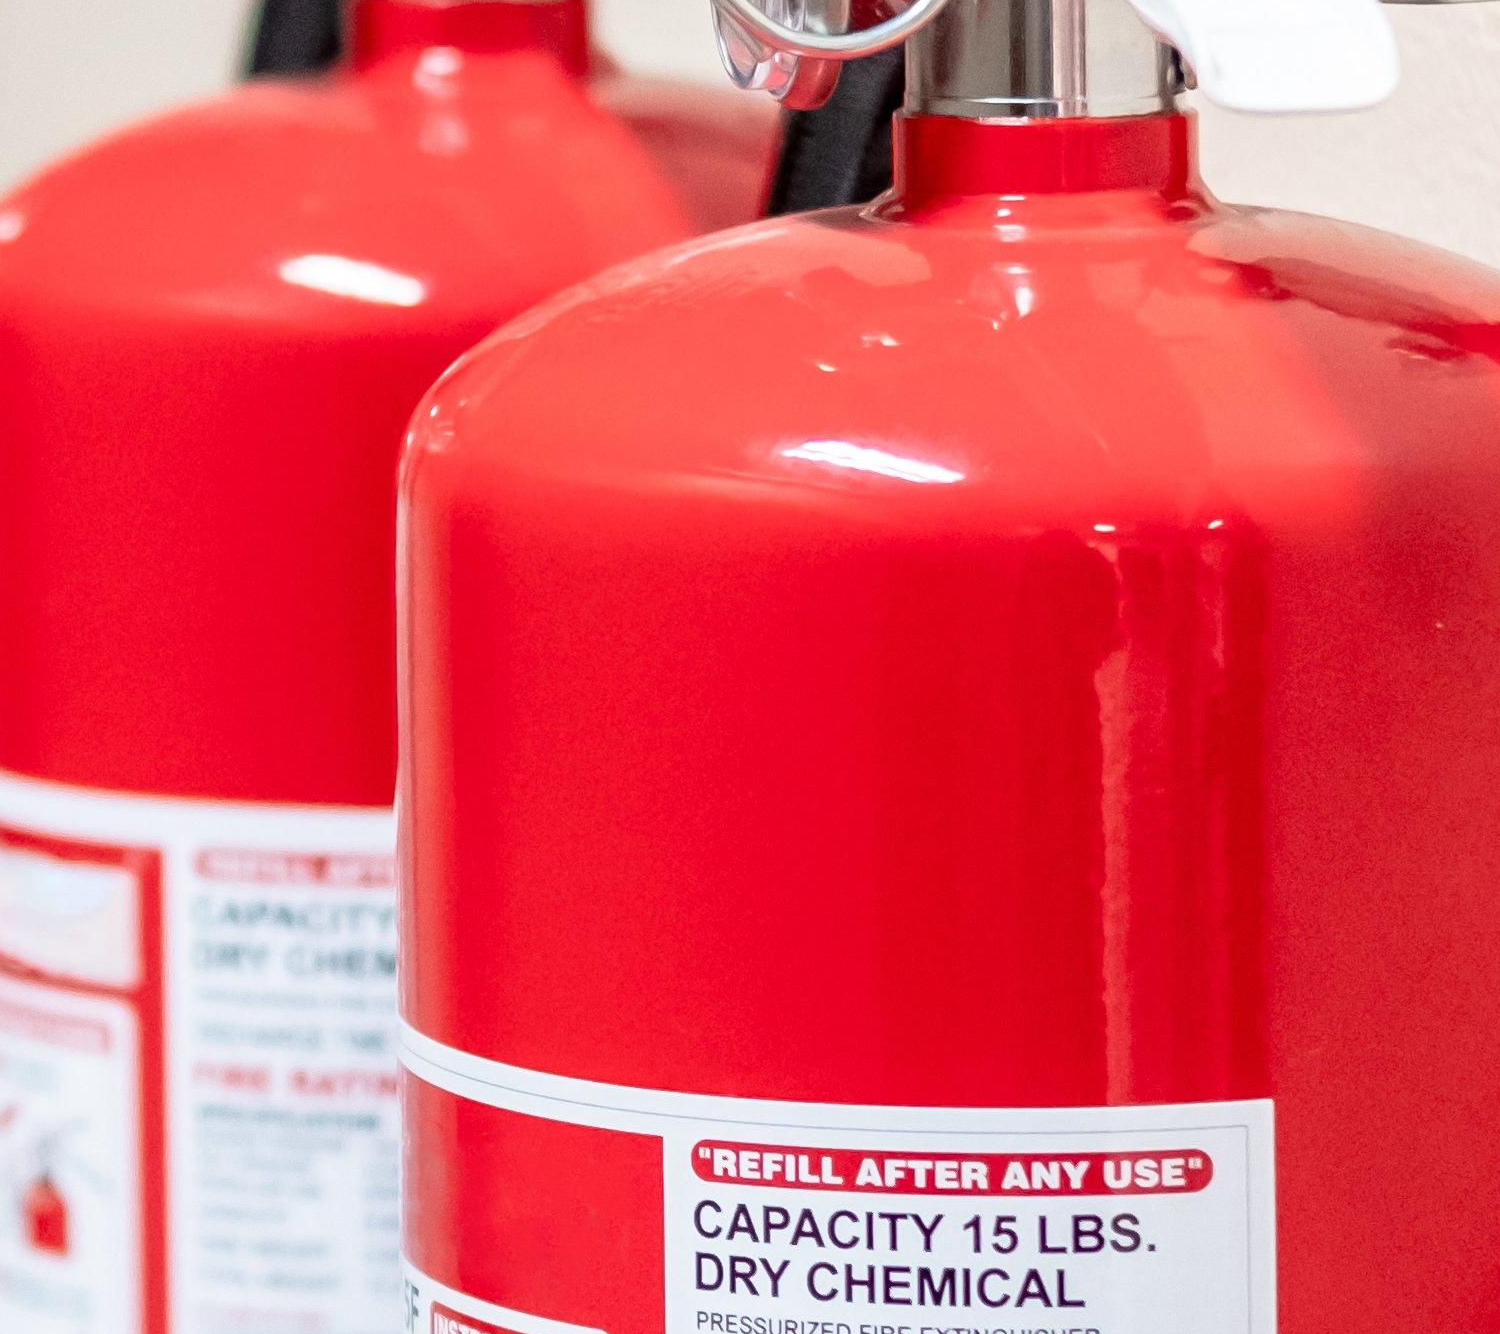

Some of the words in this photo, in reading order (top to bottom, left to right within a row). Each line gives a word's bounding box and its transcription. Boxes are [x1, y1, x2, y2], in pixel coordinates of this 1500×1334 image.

[698, 1147, 844, 1185] "REFILL
[856, 1158, 989, 1188] AFTER
[1002, 1161, 1090, 1188] ANY
[1103, 1158, 1203, 1187] USE"
[694, 1199, 943, 1253] CAPACITY
[964, 1215, 1018, 1255] 15
[1039, 1213, 1155, 1254] LBS.
[696, 1251, 790, 1298] DRY
[807, 1261, 1085, 1308] CHEMICAL
